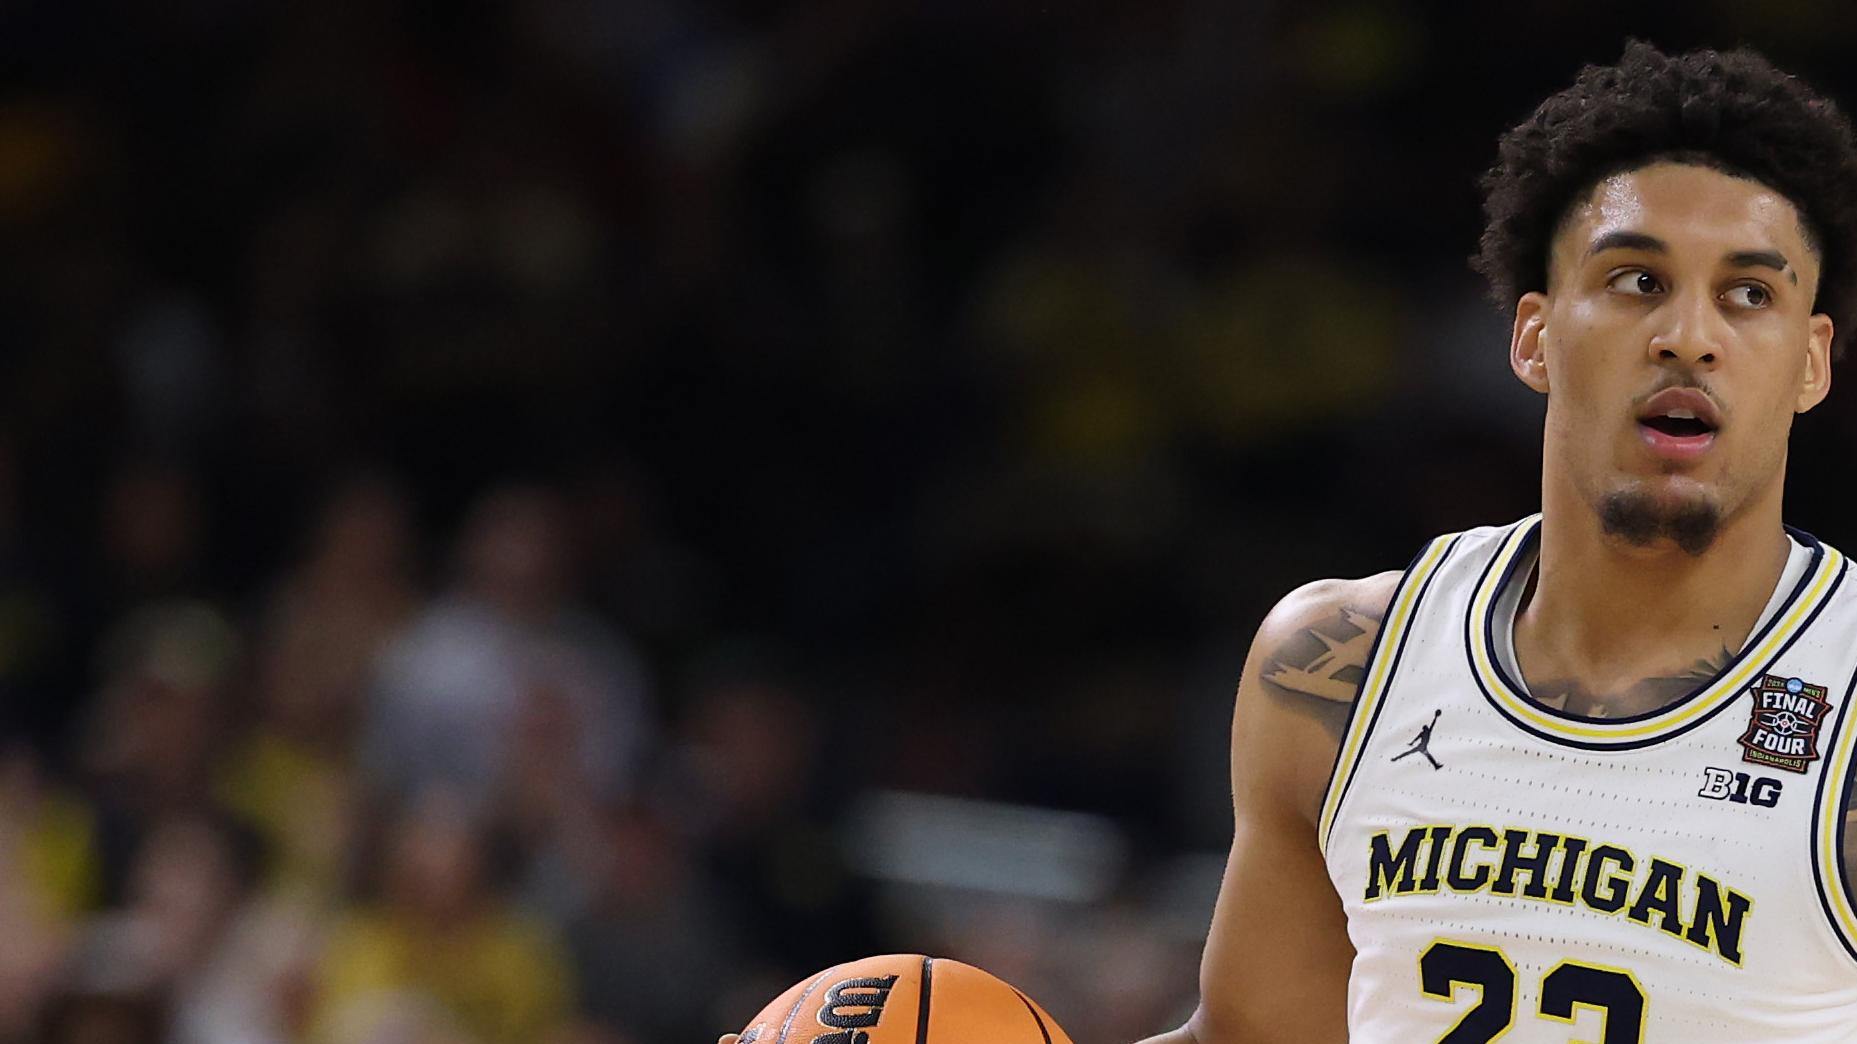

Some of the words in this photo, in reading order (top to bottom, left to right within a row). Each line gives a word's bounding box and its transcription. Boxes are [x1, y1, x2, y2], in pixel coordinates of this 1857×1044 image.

[1762, 691, 1816, 718] FINAL
[1752, 728, 1806, 755] FOUR
[1750, 750, 1802, 767] INDIANAPOLIS
[1364, 824, 1754, 969] MICHIGAN
